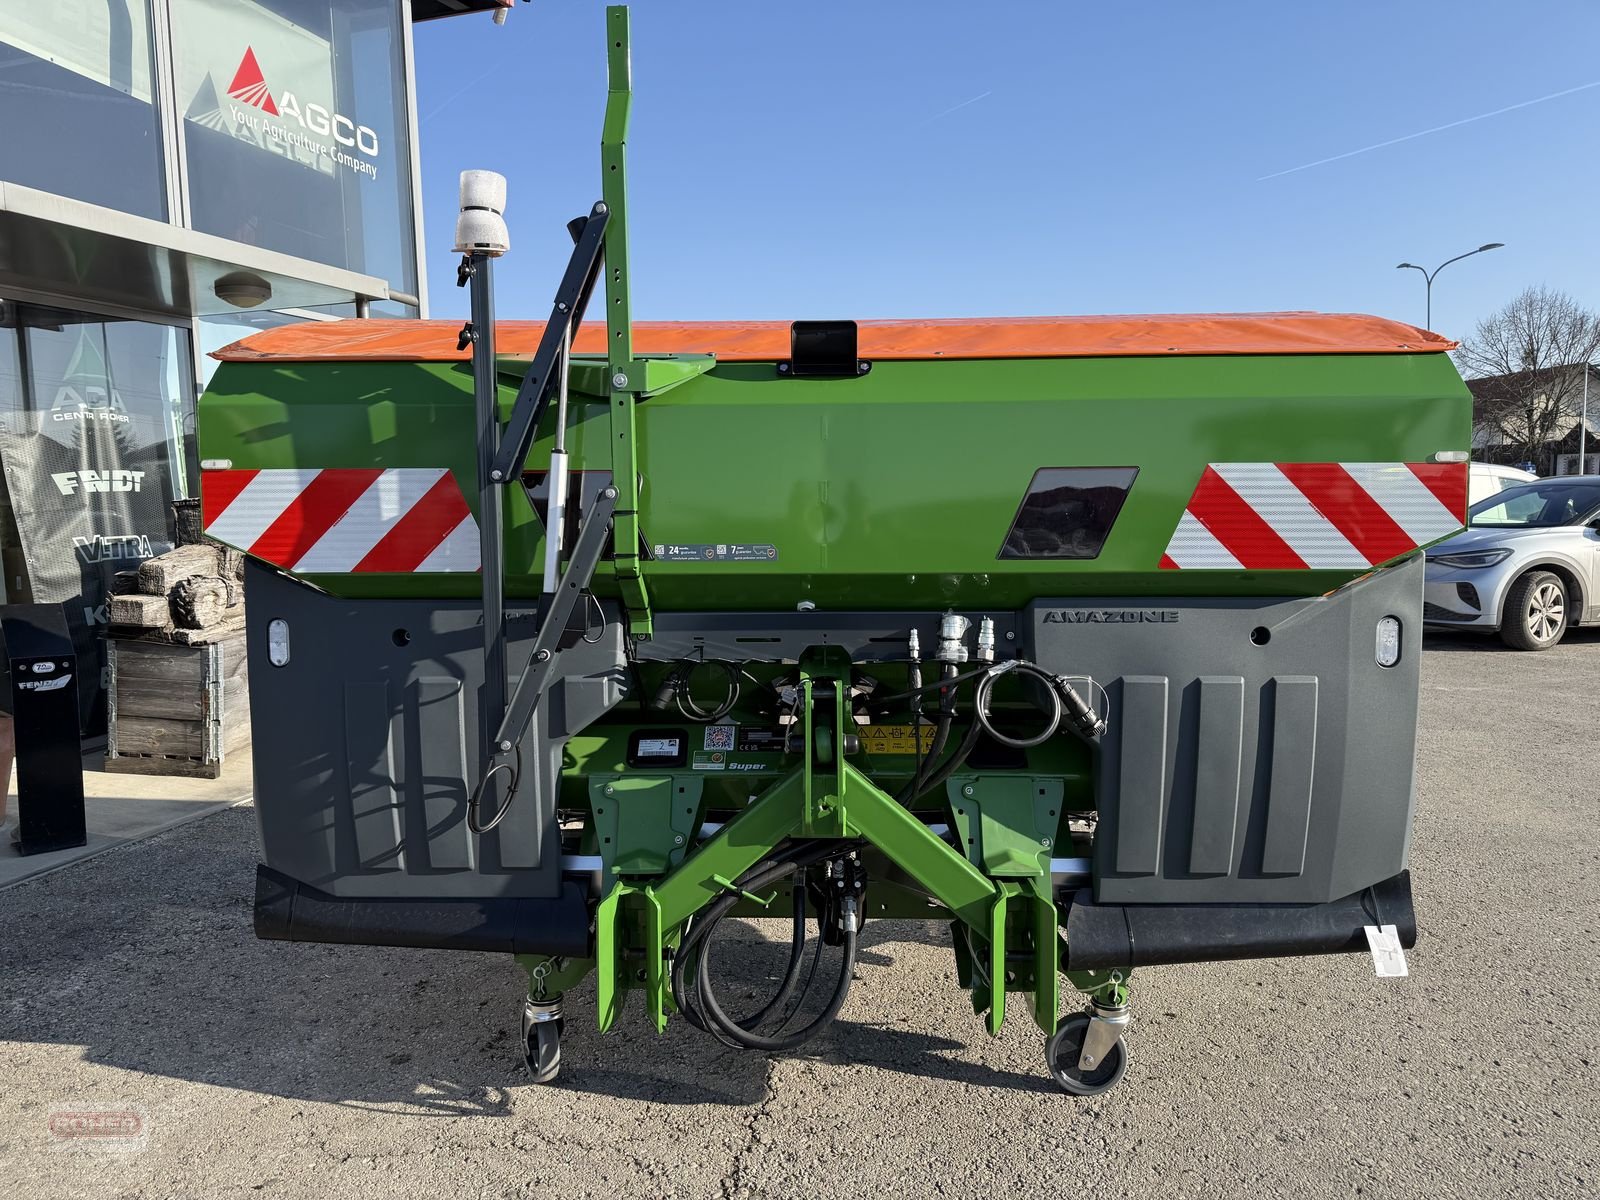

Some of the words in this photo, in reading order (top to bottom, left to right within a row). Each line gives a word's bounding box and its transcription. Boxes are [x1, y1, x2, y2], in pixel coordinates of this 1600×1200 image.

[278, 91, 379, 157] AGCO
[229, 103, 258, 130] Your
[262, 118, 327, 158] Agriculture
[330, 146, 378, 180] Company
[668, 545, 680, 555] 24
[730, 545, 737, 555] 7
[1042, 610, 1180, 624] AMAZONE
[728, 762, 767, 771] Super
